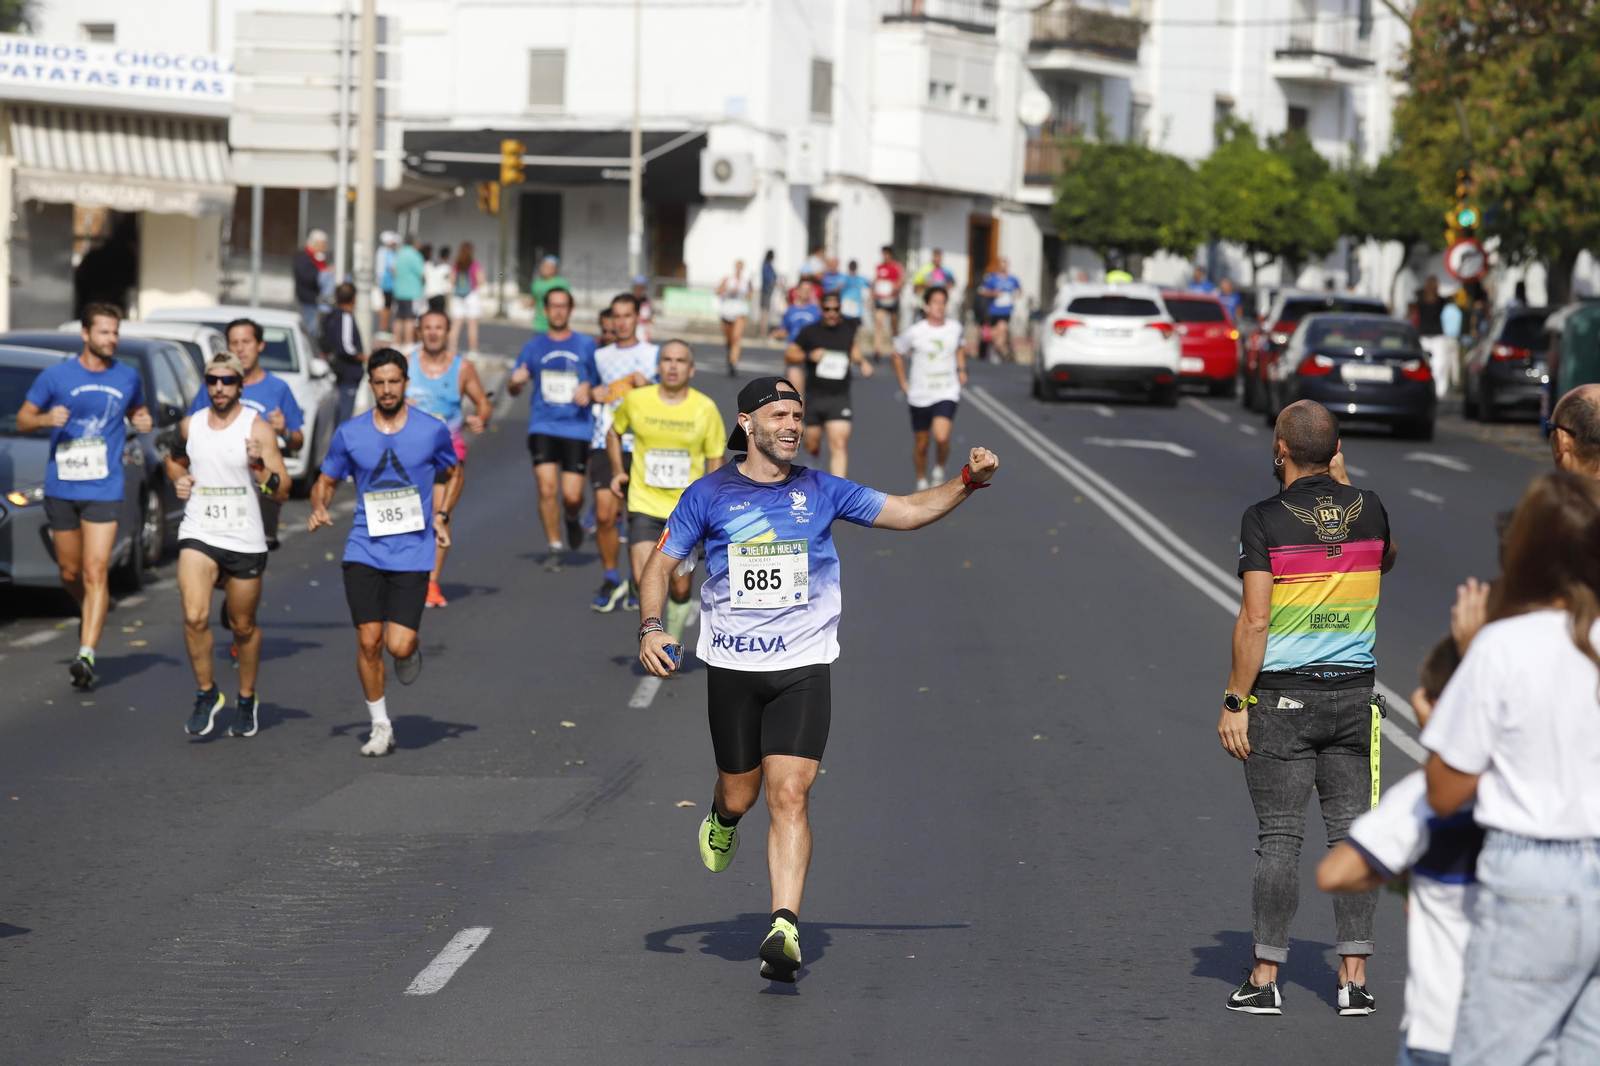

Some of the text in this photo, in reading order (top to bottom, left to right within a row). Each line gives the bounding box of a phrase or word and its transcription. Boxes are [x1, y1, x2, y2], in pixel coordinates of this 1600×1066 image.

[130, 74, 224, 95] FRITAS
[204, 504, 228, 519] 431
[376, 507, 404, 523] 385
[770, 545, 776, 554] A
[743, 568, 782, 591] 685
[1309, 612, 1350, 623] IBHOLA
[711, 632, 787, 653] HUELVA
